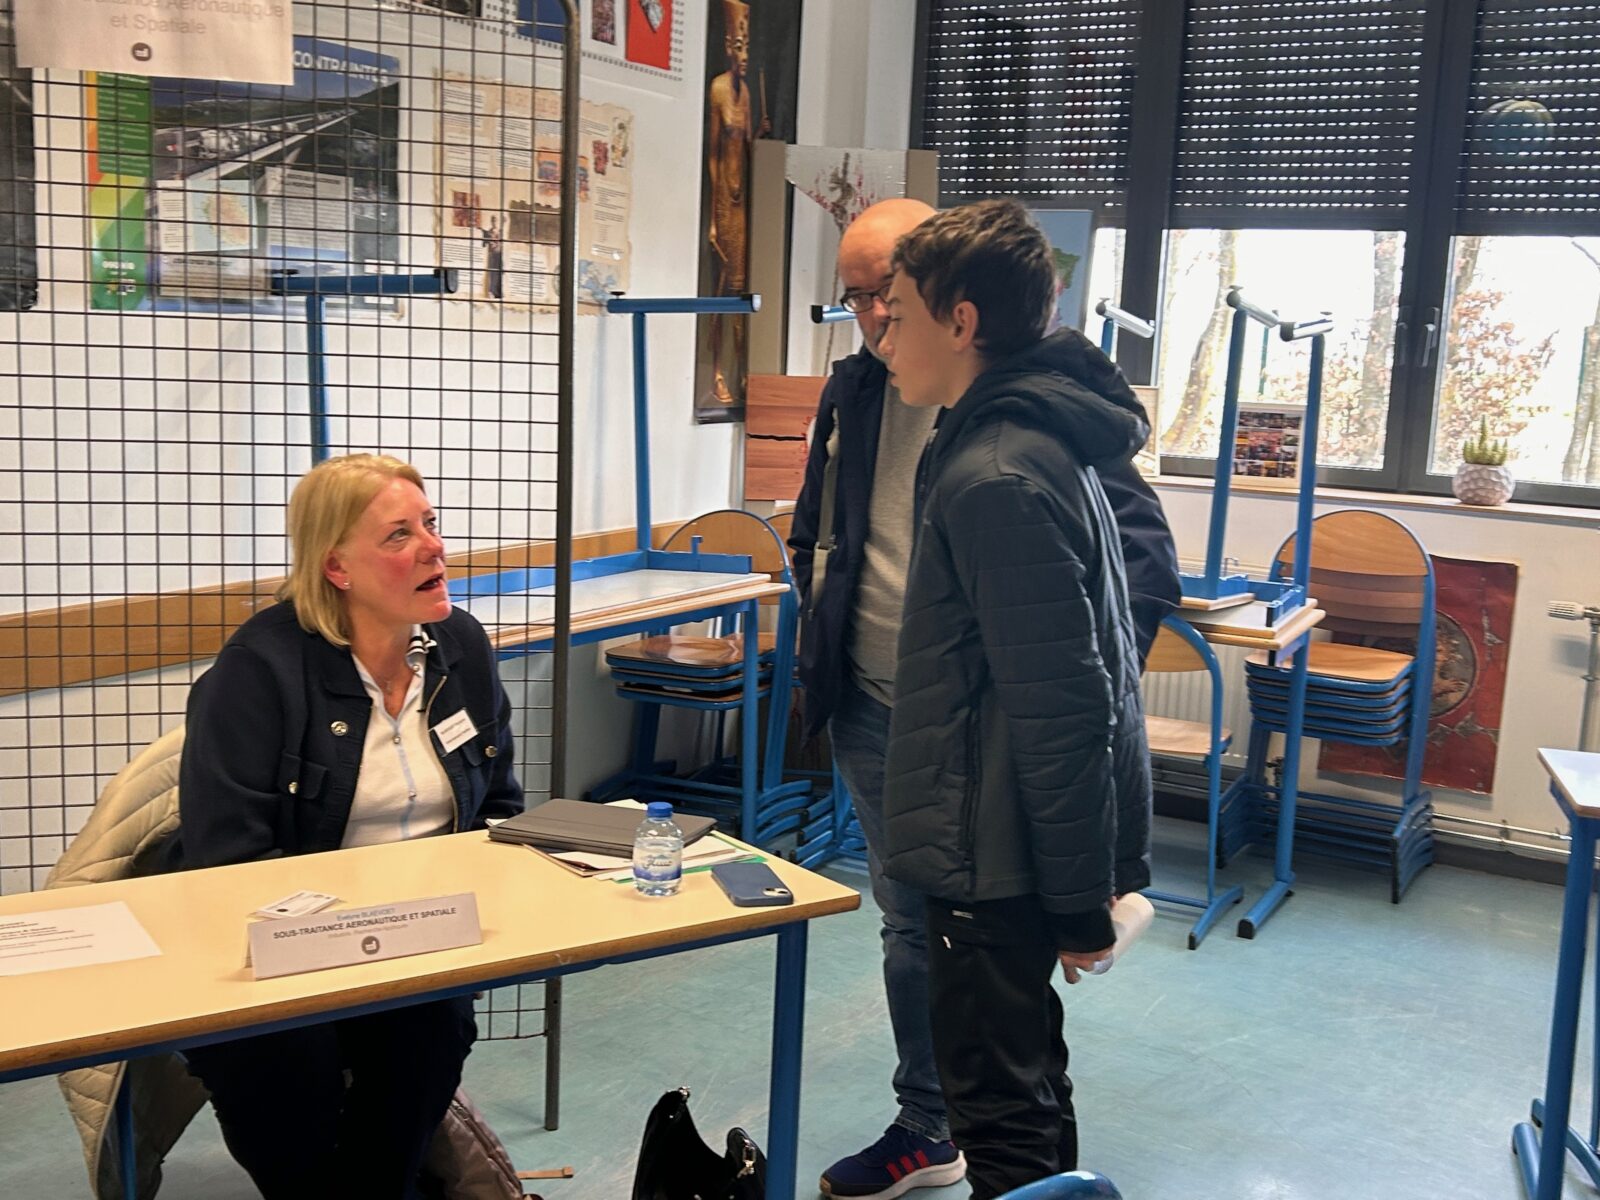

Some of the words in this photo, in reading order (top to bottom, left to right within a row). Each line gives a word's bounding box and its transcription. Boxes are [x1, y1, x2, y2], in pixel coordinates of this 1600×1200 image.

[110, 14, 128, 28] et
[134, 14, 207, 34] Spatiale
[273, 923, 344, 939] SOUS-TRAITANCE
[345, 913, 408, 929] AERONAUTIQUE
[409, 911, 419, 921] ET
[421, 906, 457, 919] SPATIALE
